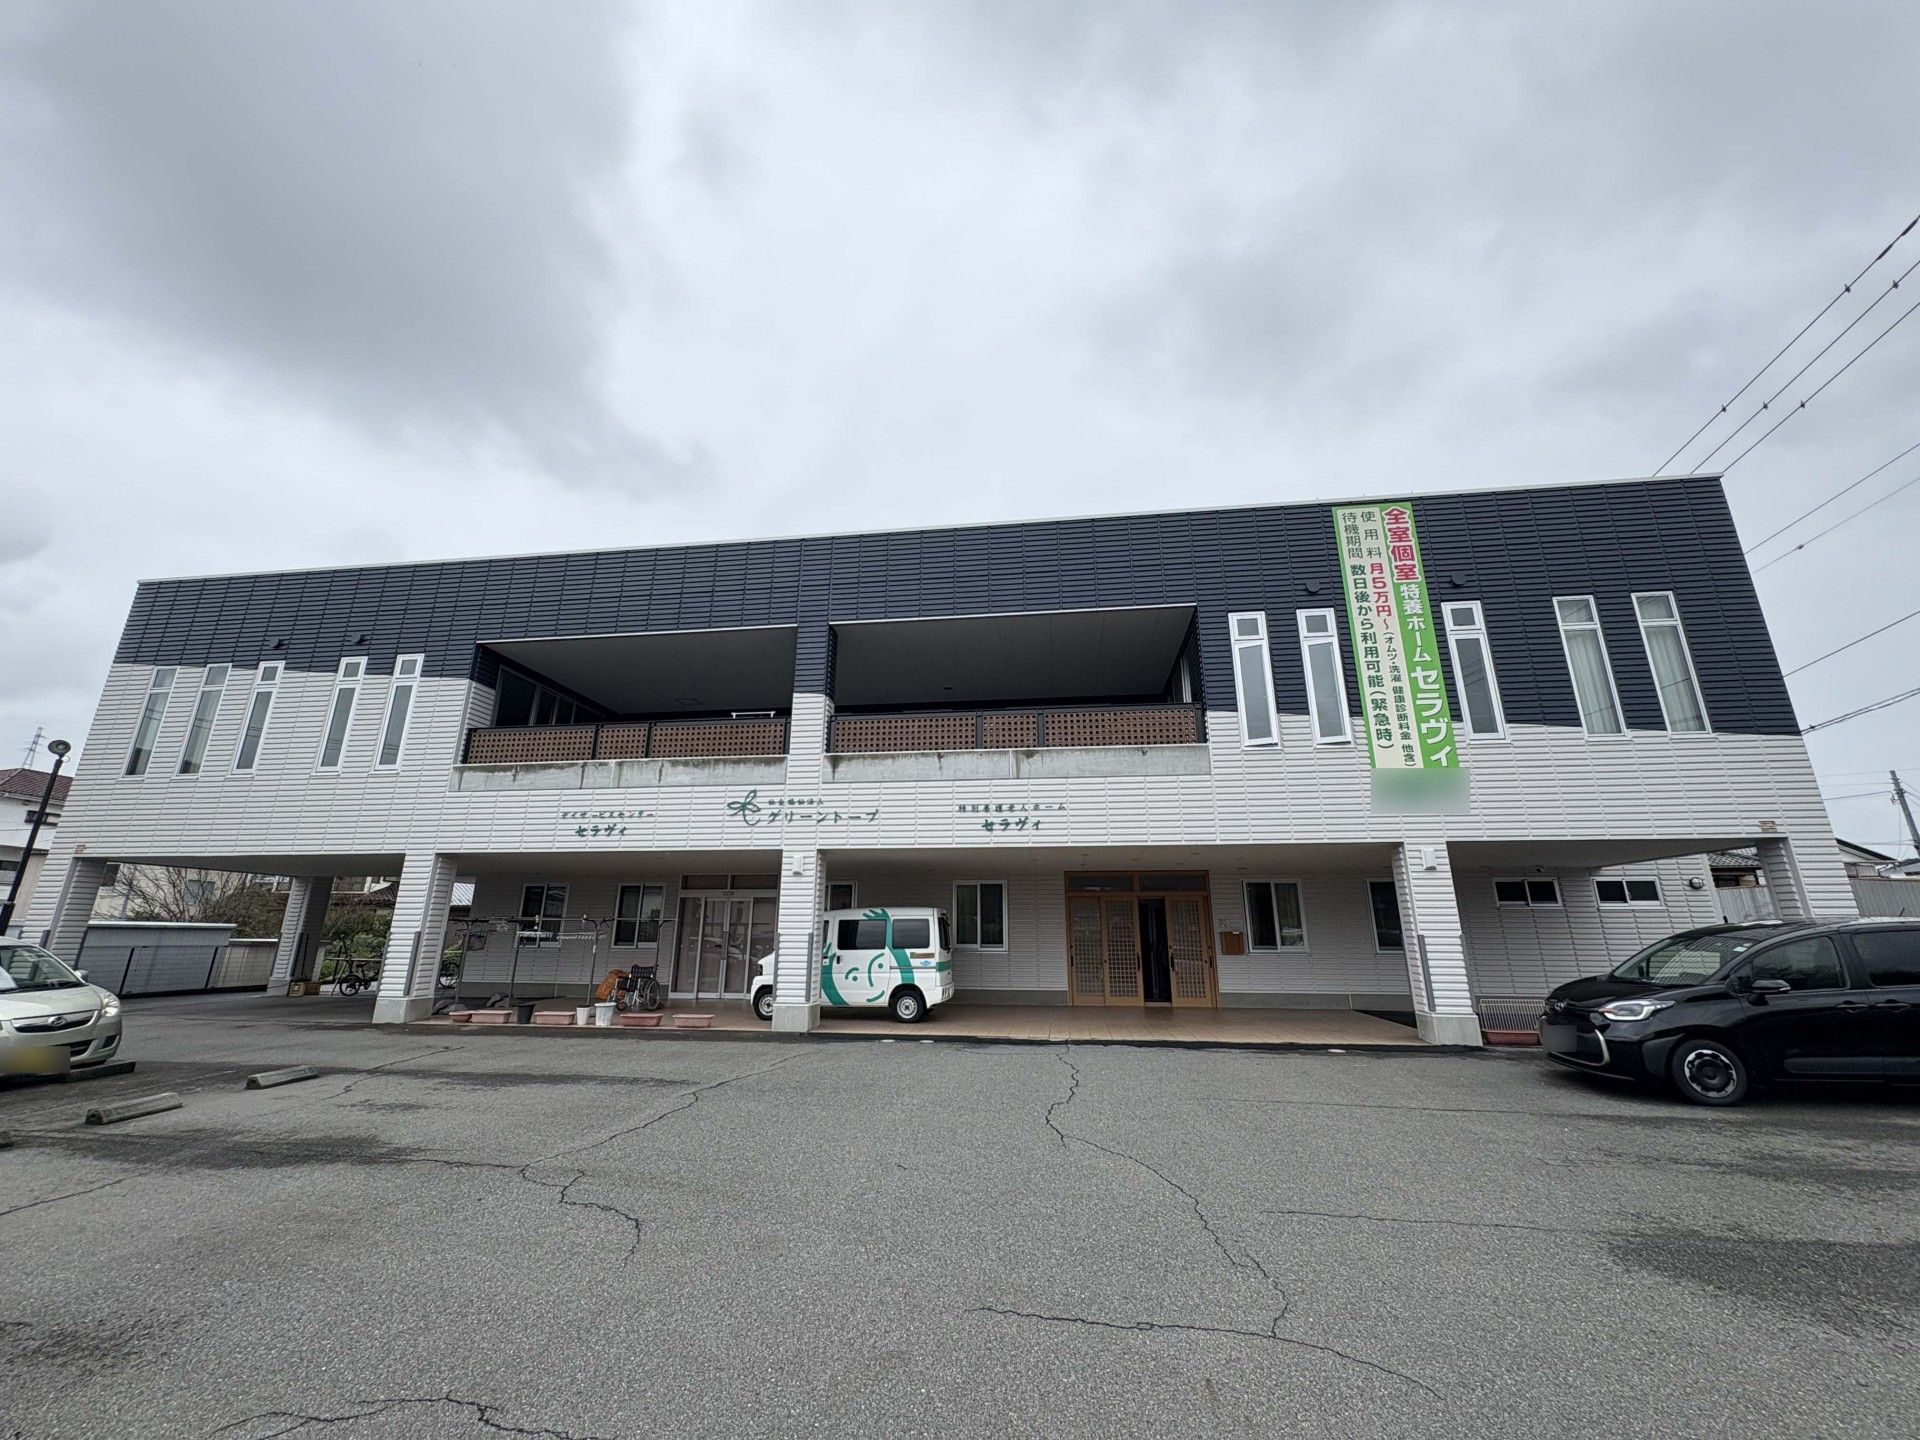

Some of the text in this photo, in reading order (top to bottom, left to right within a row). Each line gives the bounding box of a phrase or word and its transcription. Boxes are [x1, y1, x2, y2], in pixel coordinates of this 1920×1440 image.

[1342, 512, 1363, 559] 待機期間
[1361, 511, 1382, 559] 使用料
[1392, 686, 1412, 740] 健康診断料金
[1384, 507, 1420, 581] 全室個室
[1411, 666, 1453, 767] セラヴィ
[575, 823, 627, 837] セラヴィ
[981, 816, 1041, 831] セラヴィ
